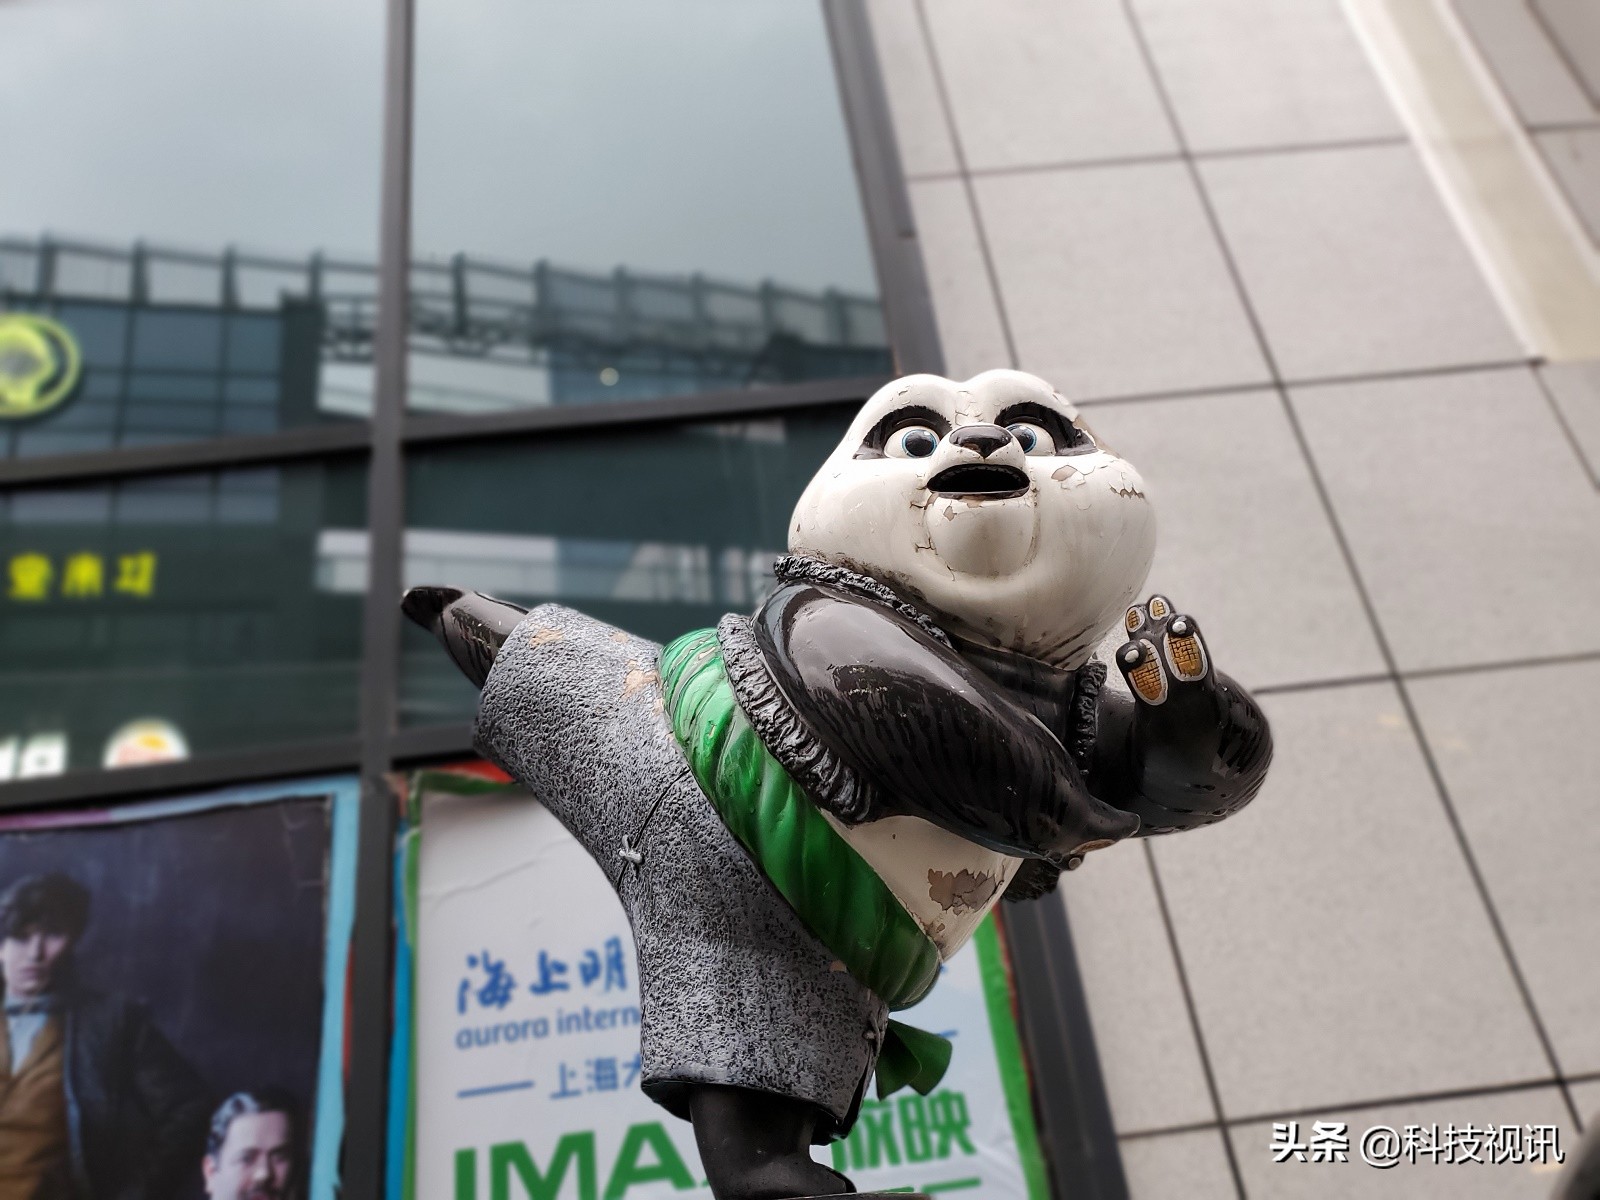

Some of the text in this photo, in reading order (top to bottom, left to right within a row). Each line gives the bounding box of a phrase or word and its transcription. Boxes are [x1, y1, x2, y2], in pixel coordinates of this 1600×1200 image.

[457, 936, 627, 1014] 海上明
[455, 1016, 549, 1050] aurora
[454, 1119, 710, 1200] IMA
